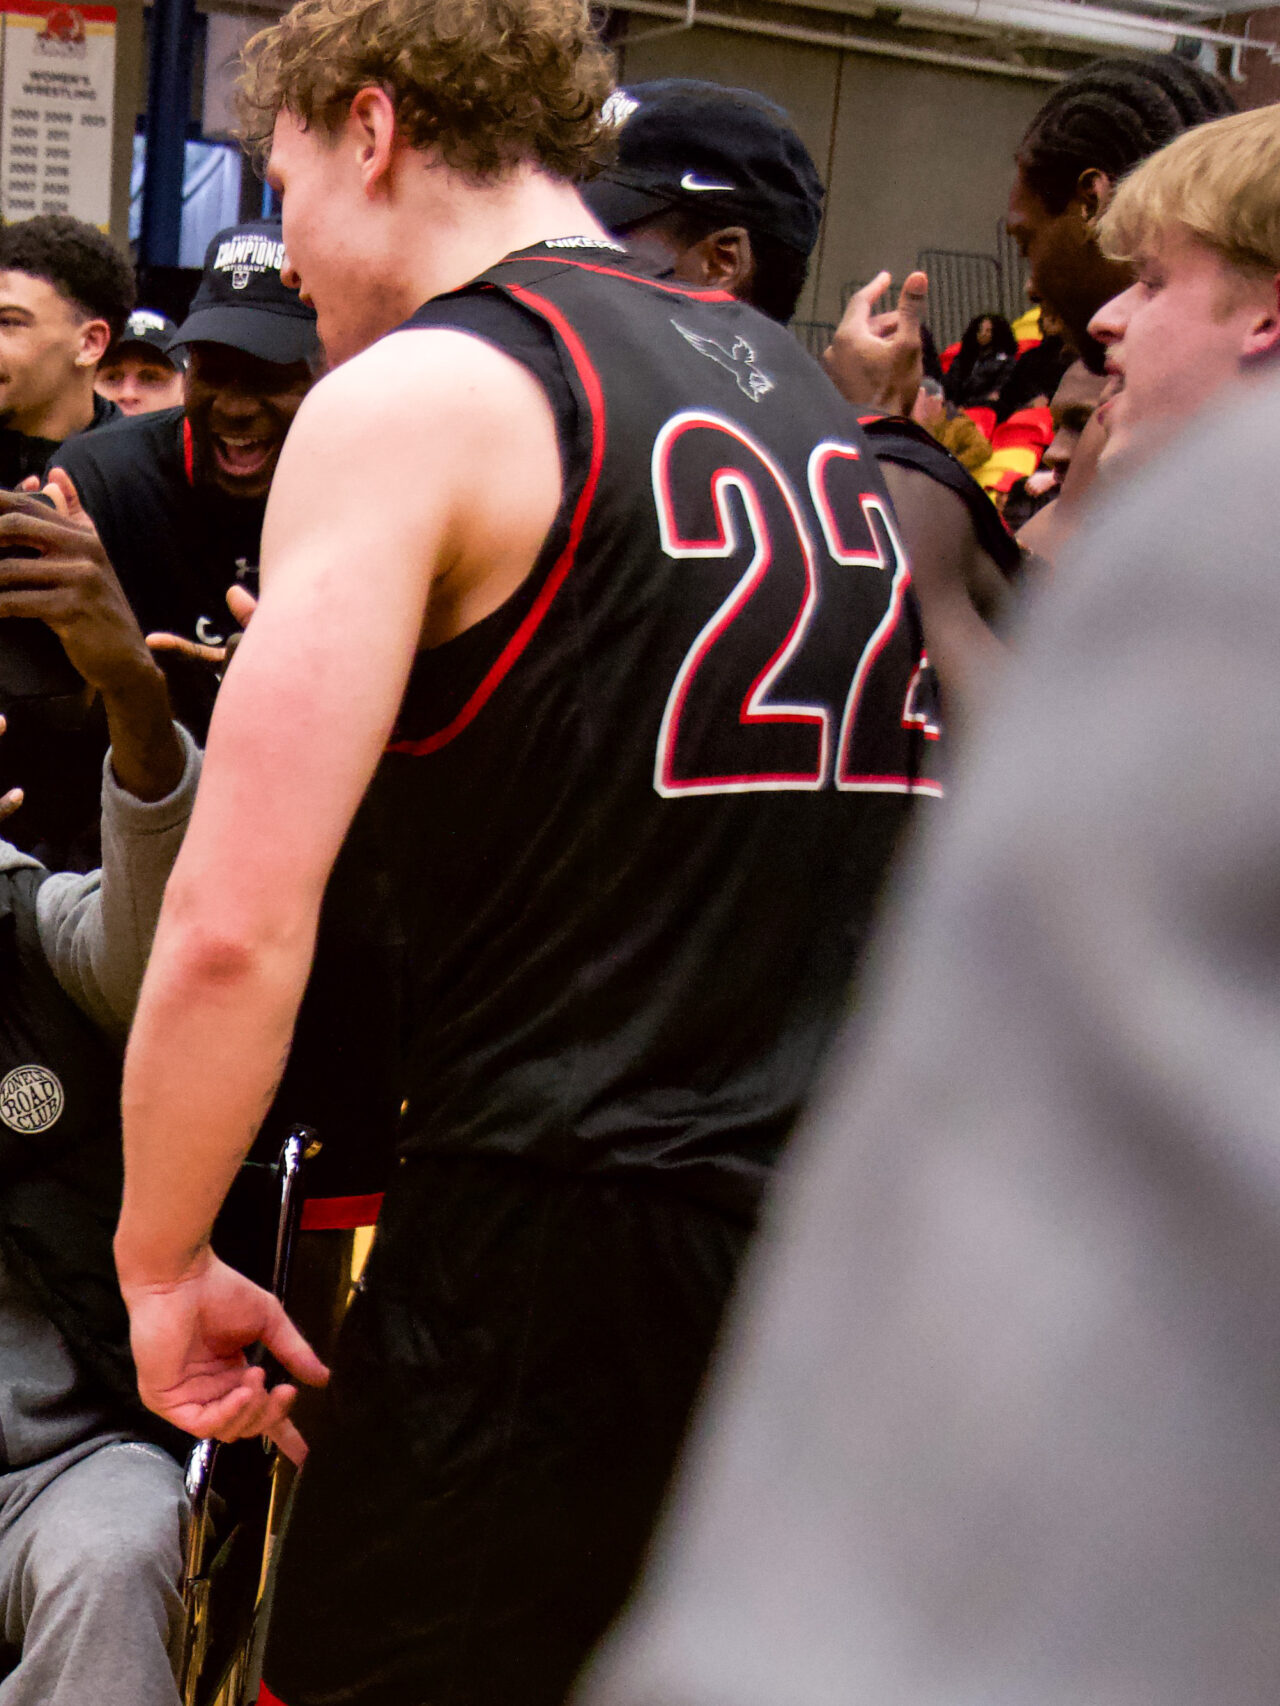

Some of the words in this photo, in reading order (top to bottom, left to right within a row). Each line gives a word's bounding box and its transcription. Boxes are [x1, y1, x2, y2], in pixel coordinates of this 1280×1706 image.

[22, 84, 97, 100] WRESTLING
[30, 71, 90, 86] WOMEN'S
[214, 241, 285, 269] CHAMPIONS
[651, 408, 944, 798] 22
[3, 1080, 55, 1118] ROAD
[17, 1098, 58, 1129] CLUB
